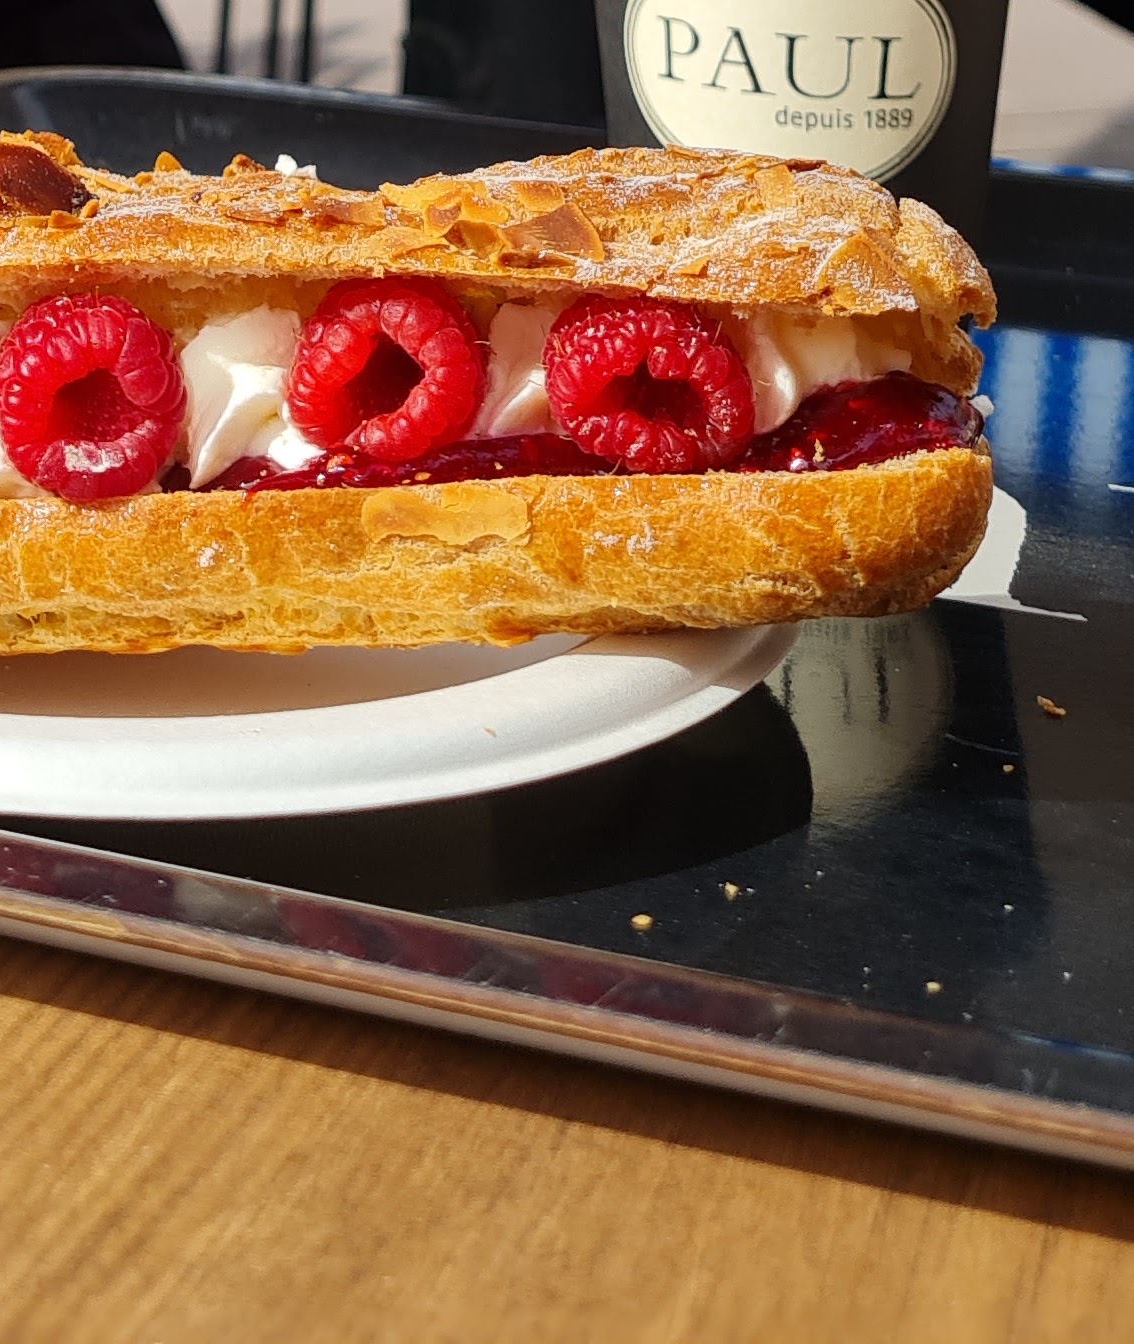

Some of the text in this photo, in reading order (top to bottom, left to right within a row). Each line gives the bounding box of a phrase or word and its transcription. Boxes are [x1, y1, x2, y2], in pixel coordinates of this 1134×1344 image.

[657, 14, 922, 100] PAUL
[774, 105, 913, 132] depuis 1889
